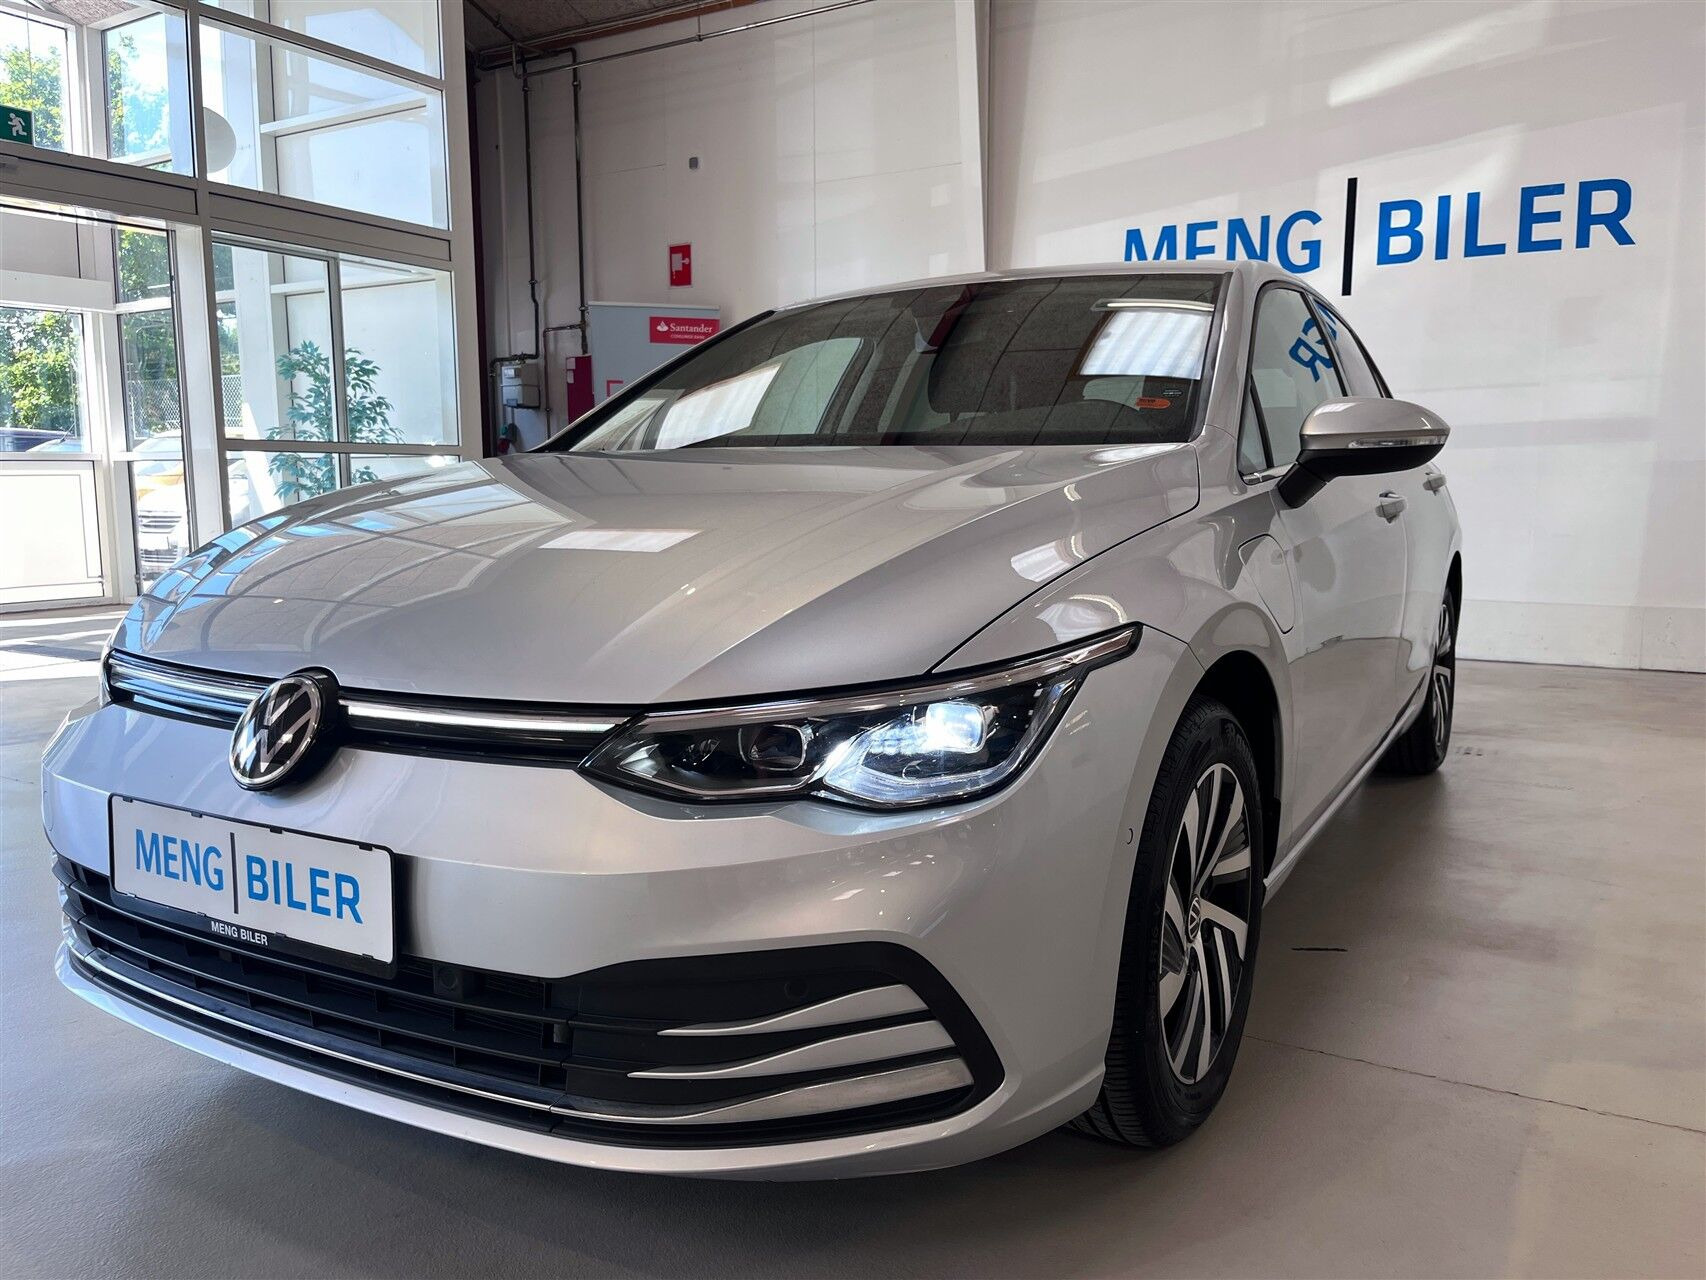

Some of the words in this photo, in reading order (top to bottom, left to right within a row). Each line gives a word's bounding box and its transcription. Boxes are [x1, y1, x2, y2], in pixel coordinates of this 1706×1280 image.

[1124, 209, 1323, 274] MENG
[1376, 178, 1636, 266] BILER
[670, 323, 713, 333] Santander
[135, 829, 225, 891] MENG
[246, 854, 364, 925] BILER
[211, 921, 238, 938] MENG
[240, 928, 268, 946] BILER
